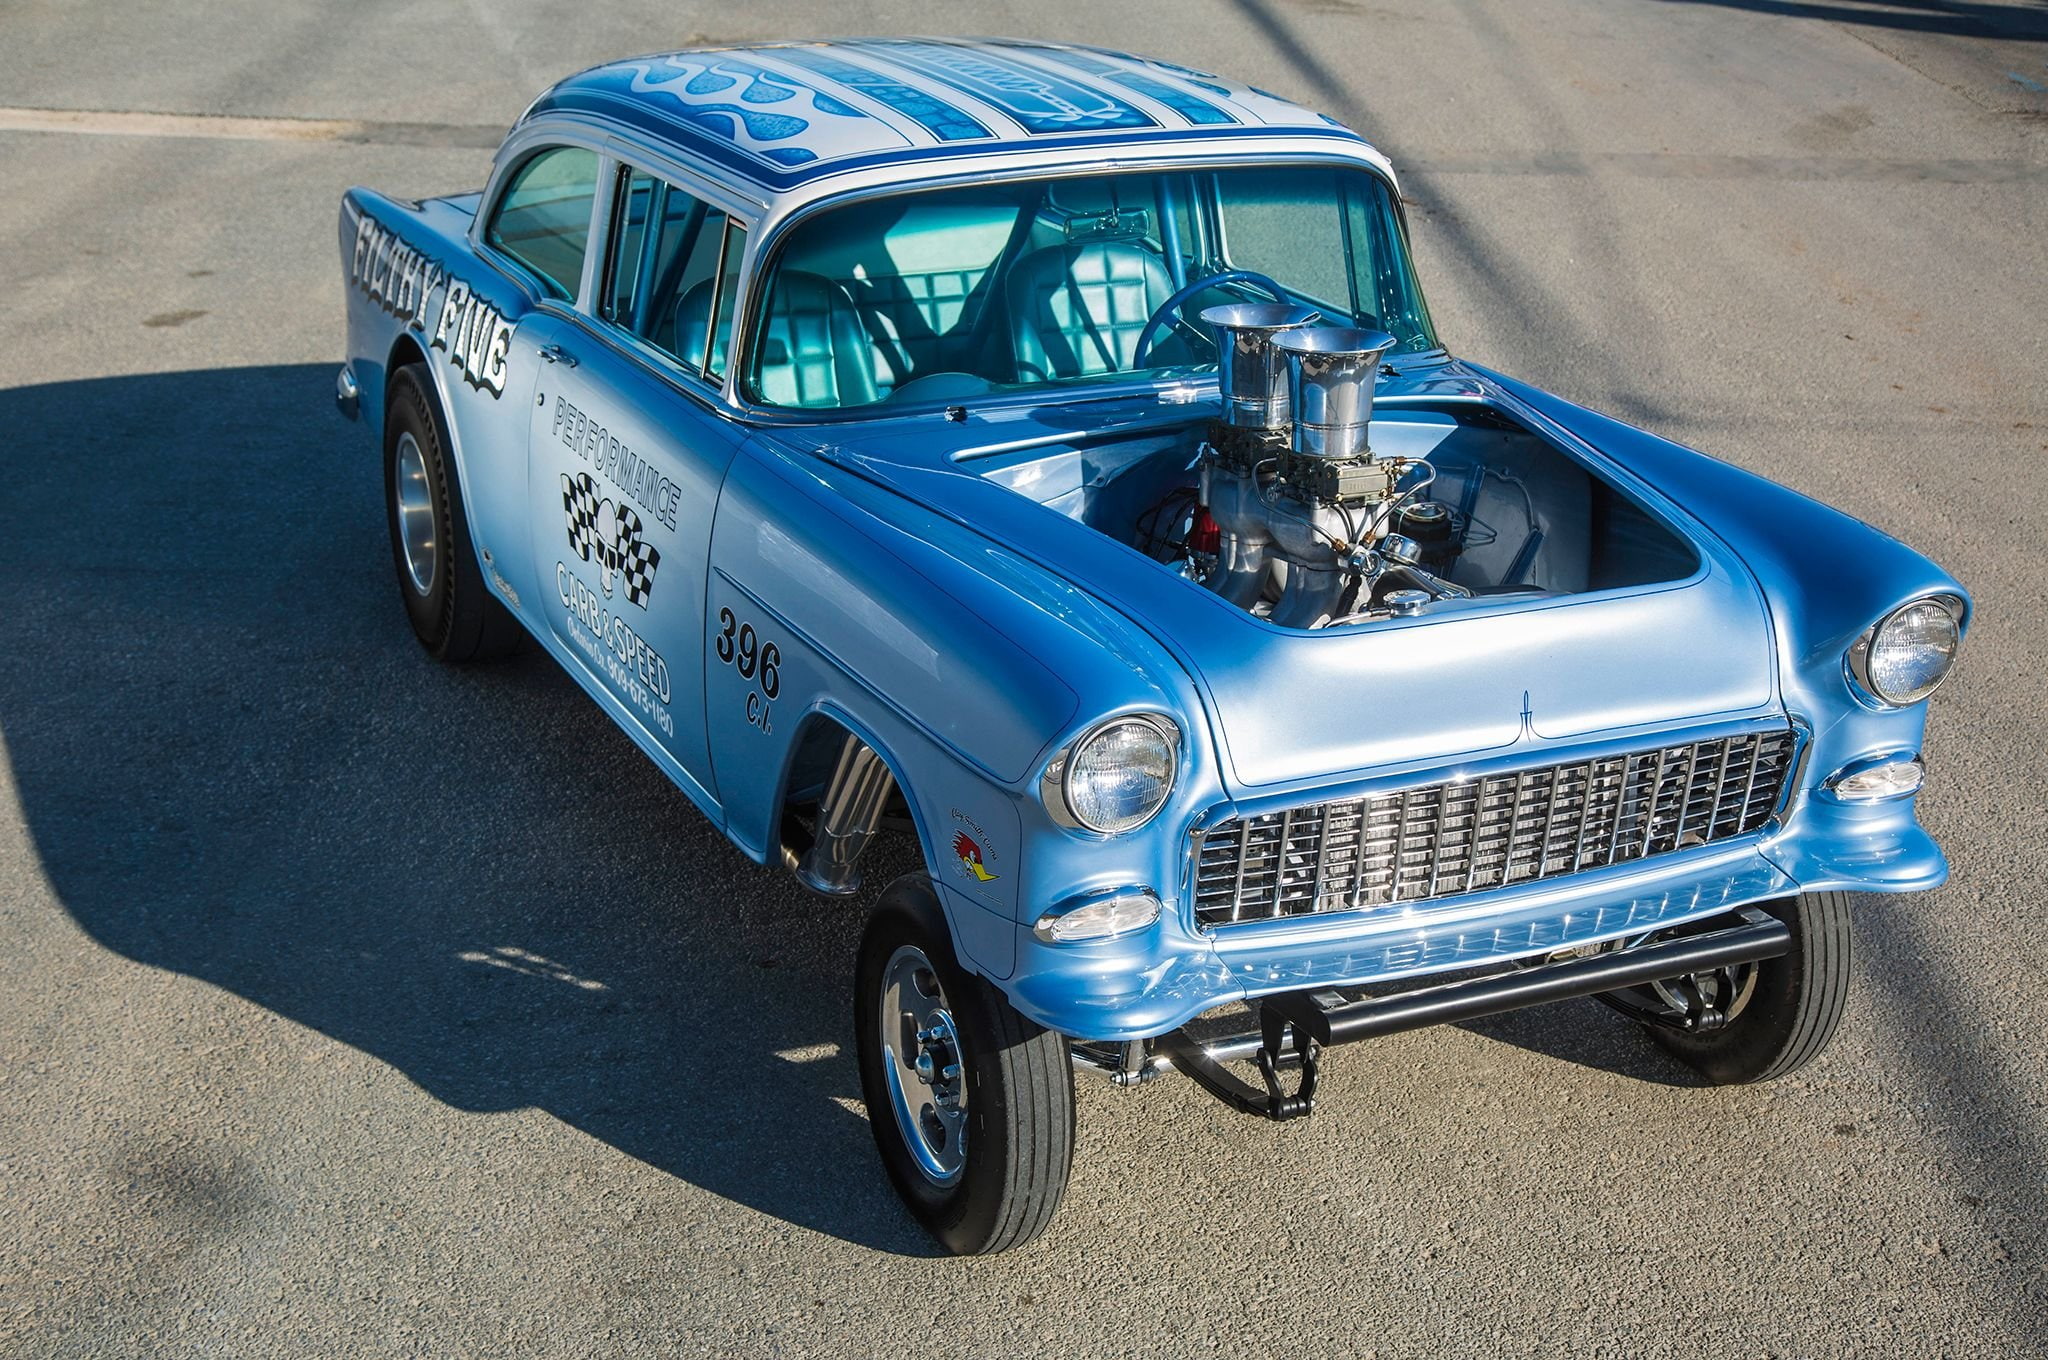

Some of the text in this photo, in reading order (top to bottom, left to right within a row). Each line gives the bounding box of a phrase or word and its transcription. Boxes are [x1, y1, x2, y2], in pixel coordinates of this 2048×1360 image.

[351, 213, 519, 399] FILTHY FIVE
[553, 396, 681, 532] PERFORMANCE
[556, 561, 603, 641] CARB
[602, 609, 615, 653] &
[614, 616, 671, 705] SPEED
[607, 655, 674, 738] 909-673-1180
[716, 605, 782, 701] 396
